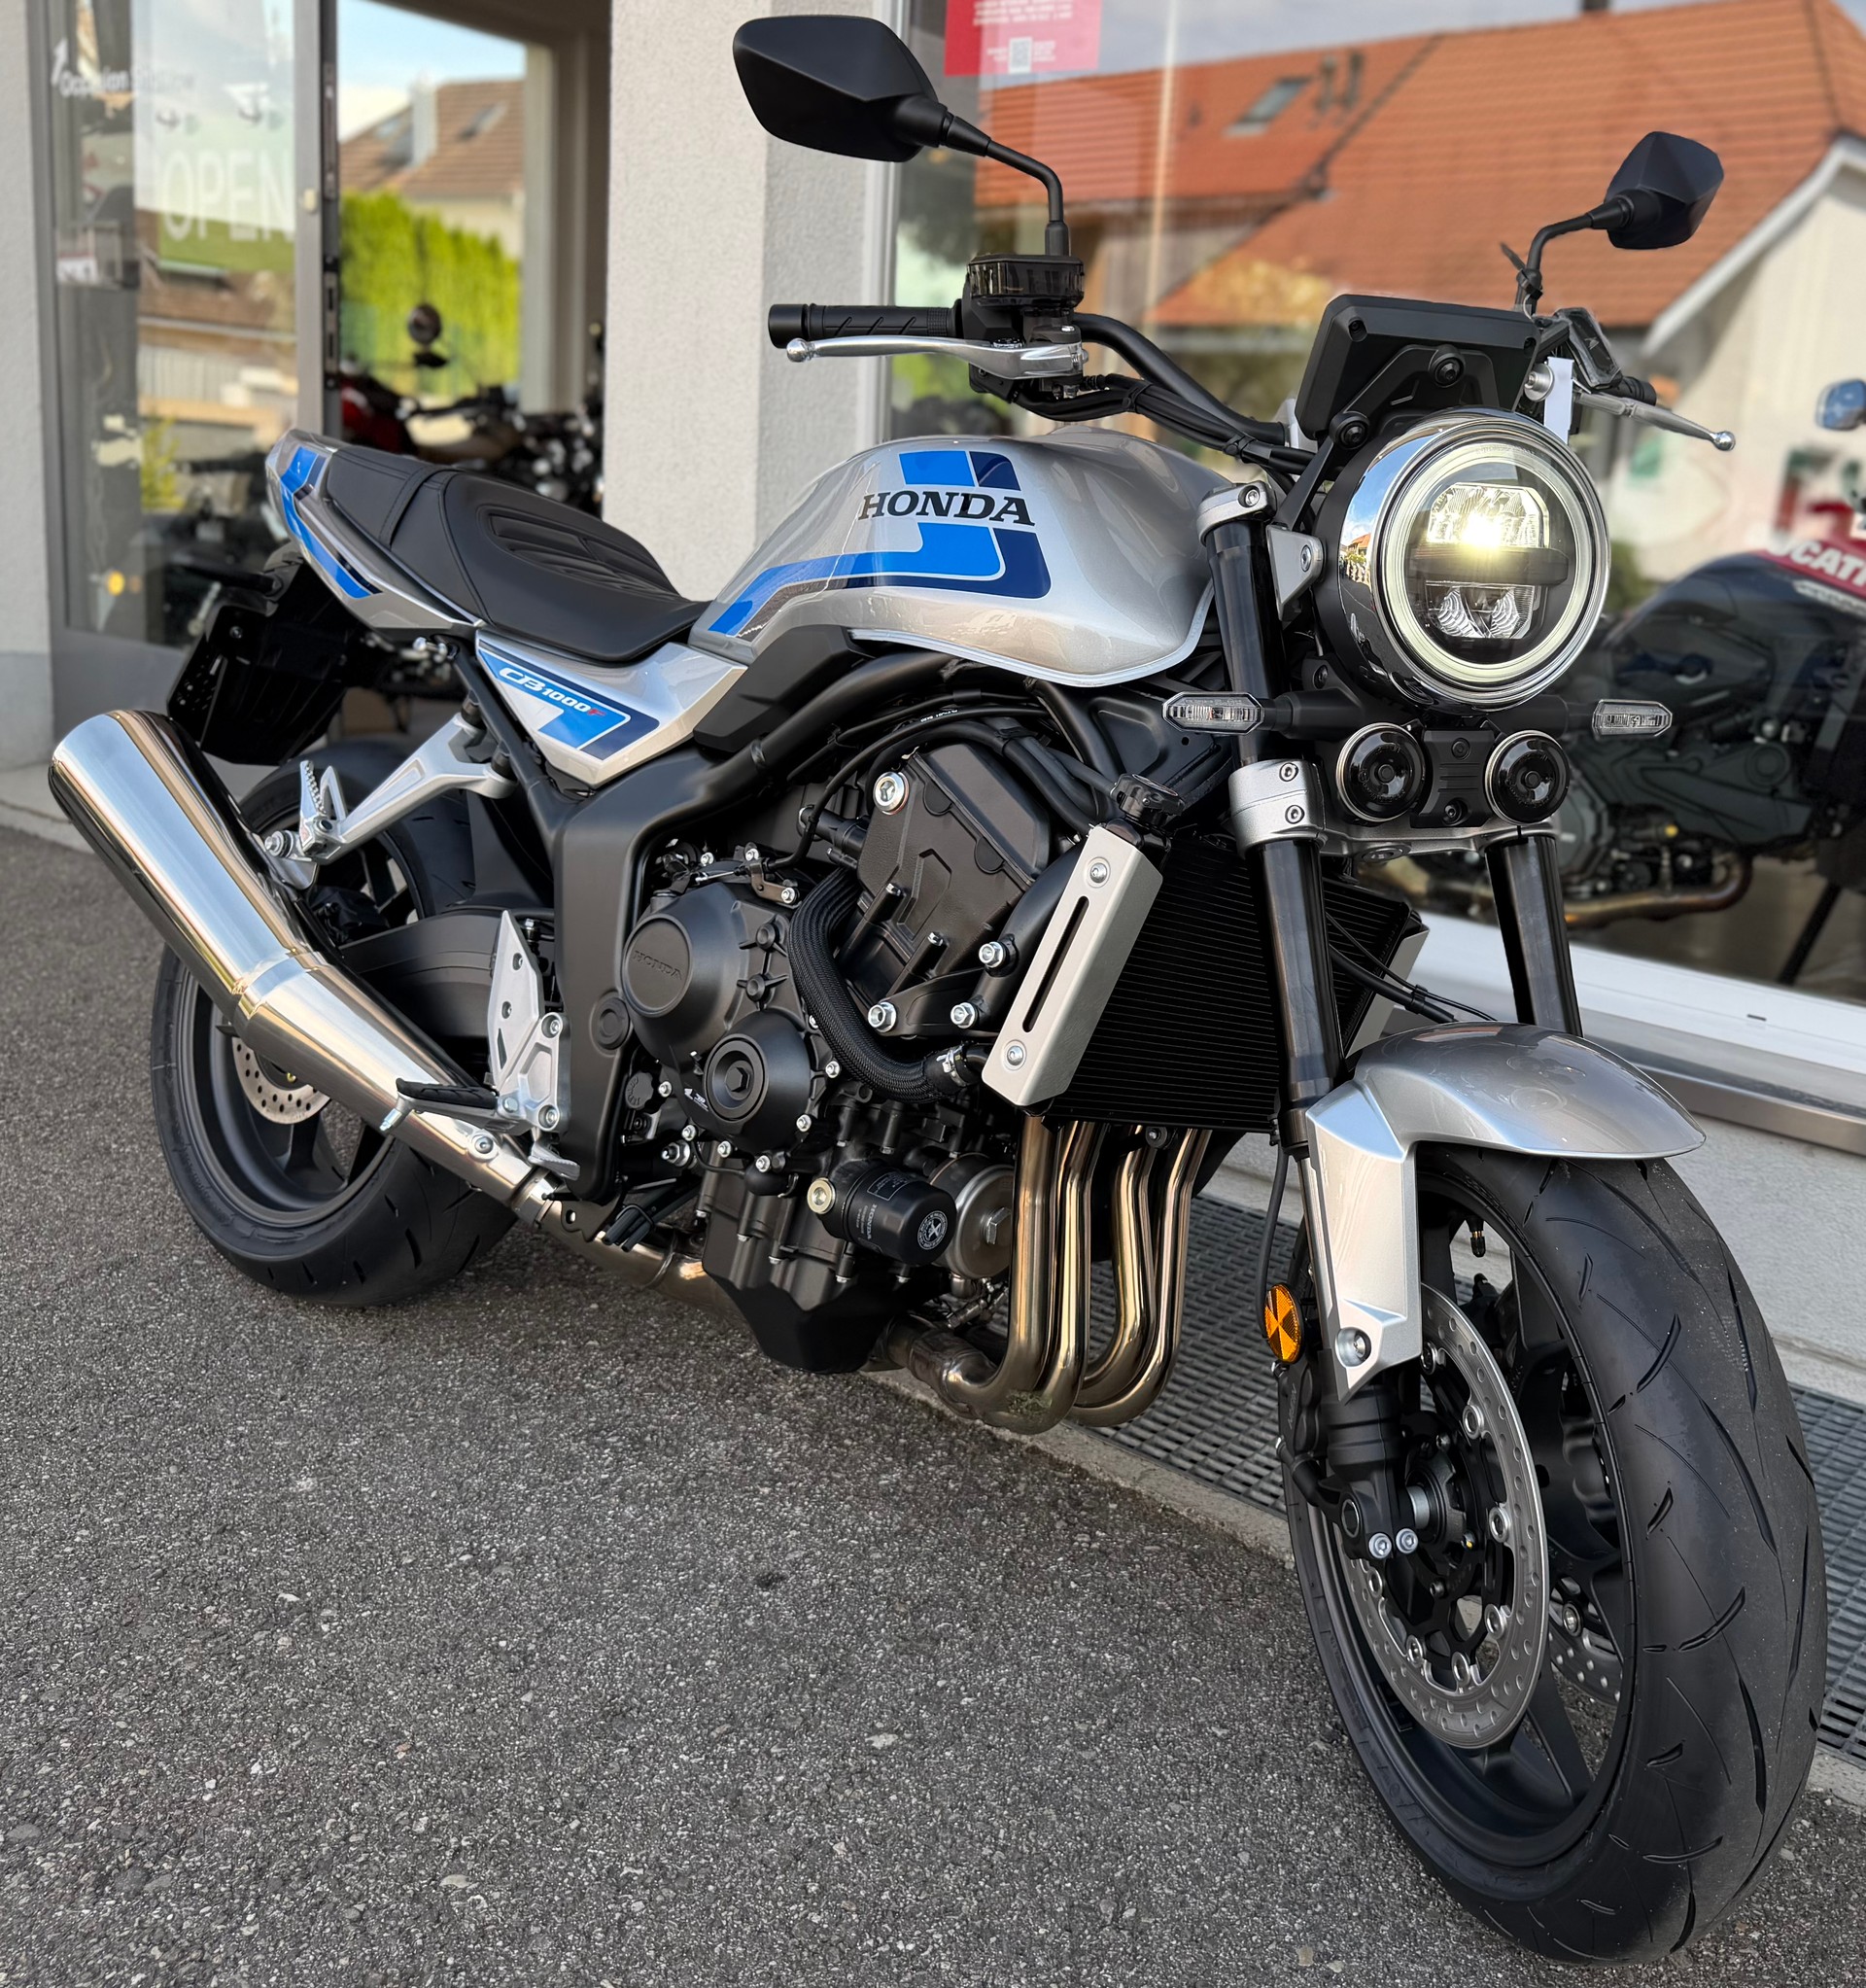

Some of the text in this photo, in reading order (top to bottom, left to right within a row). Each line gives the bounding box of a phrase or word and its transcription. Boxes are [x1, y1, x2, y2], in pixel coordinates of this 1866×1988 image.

[162, 150, 295, 242] OPEN
[858, 490, 1035, 526] HONDA
[500, 668, 606, 716] CB1000F
